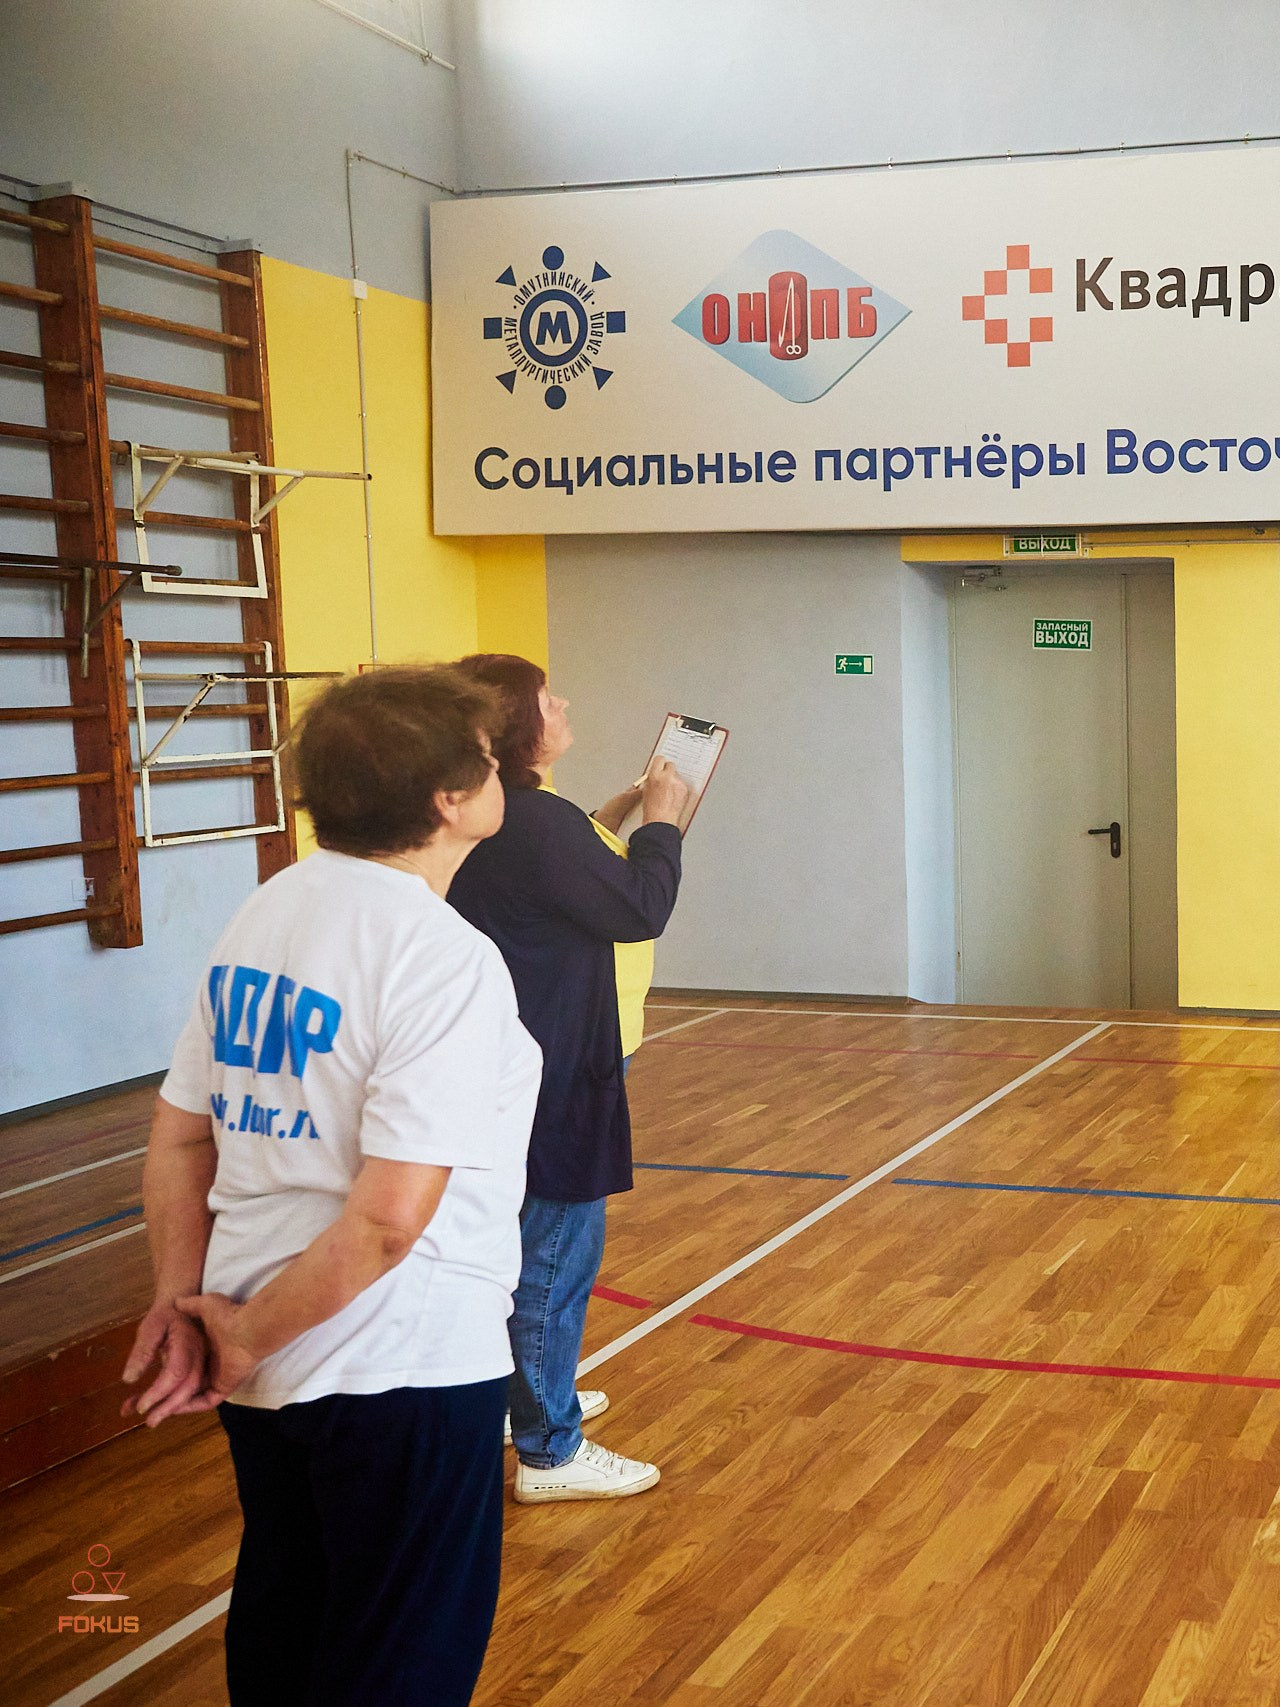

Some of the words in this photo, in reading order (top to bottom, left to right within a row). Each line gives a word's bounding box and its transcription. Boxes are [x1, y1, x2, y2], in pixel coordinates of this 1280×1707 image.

[513, 271, 596, 307] ОМУТНИНСКИЙ
[503, 316, 593, 385] МЕТАЛЛУРГИЧЕСКИЙ
[586, 311, 606, 355] ЗАВОД
[474, 445, 798, 496] Социальные
[814, 432, 1086, 492] партнёры
[1018, 538, 1072, 551] ВЫХОД
[1035, 631, 1089, 648] ВЫХОД
[1036, 622, 1089, 632] ЗАПАСНЫЙ
